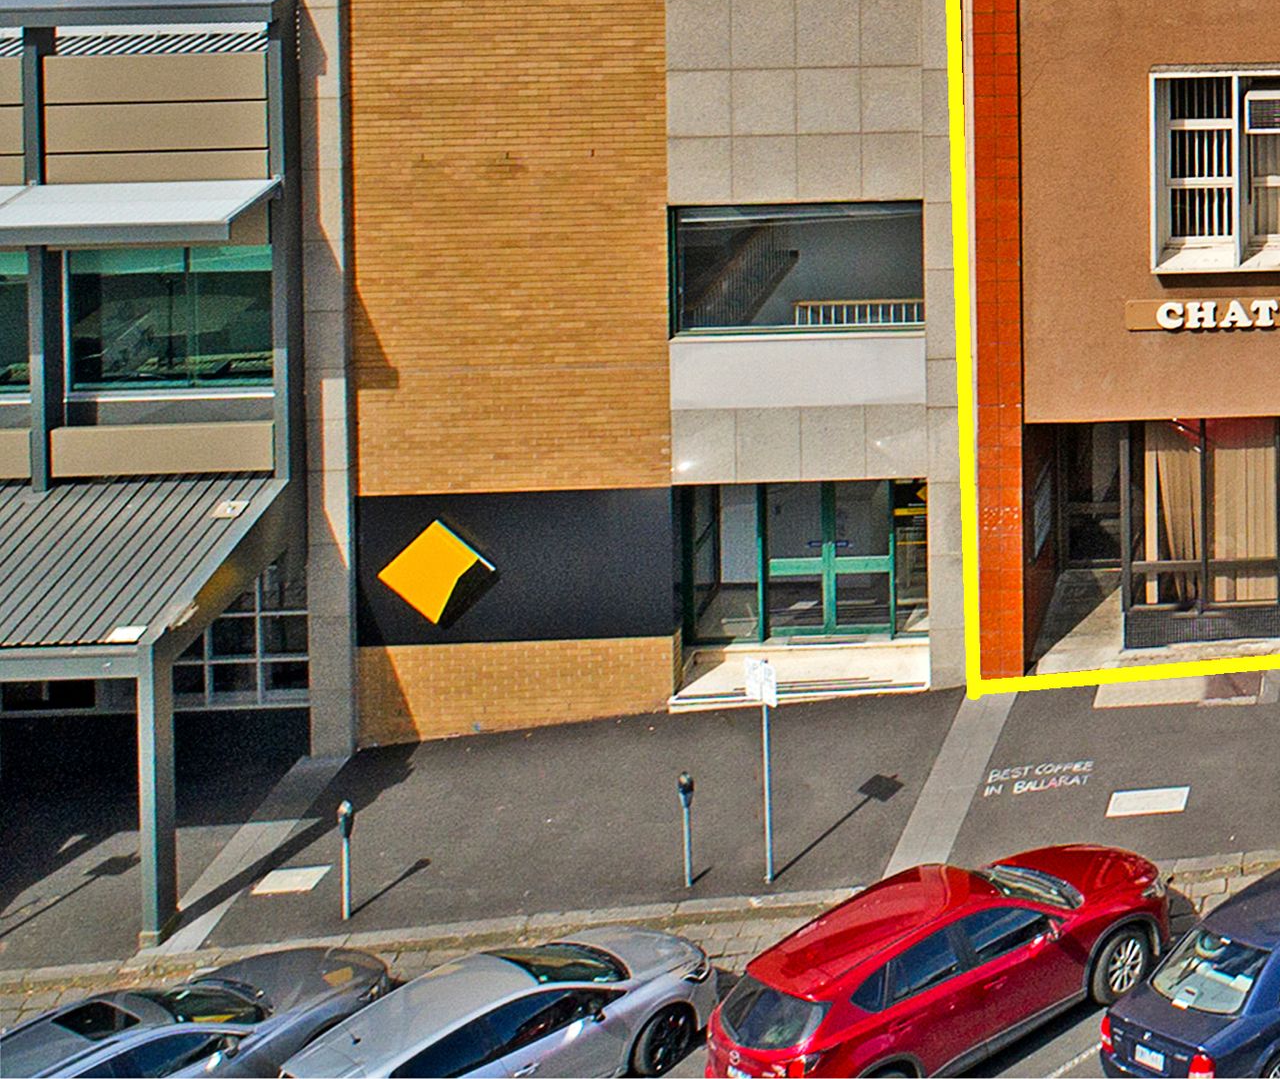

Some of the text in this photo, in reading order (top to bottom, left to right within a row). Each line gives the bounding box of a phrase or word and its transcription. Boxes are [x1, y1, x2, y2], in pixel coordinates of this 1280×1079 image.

[984, 761, 1095, 784] BEST COFFEE
[984, 775, 1089, 797] IN BALLARAT
